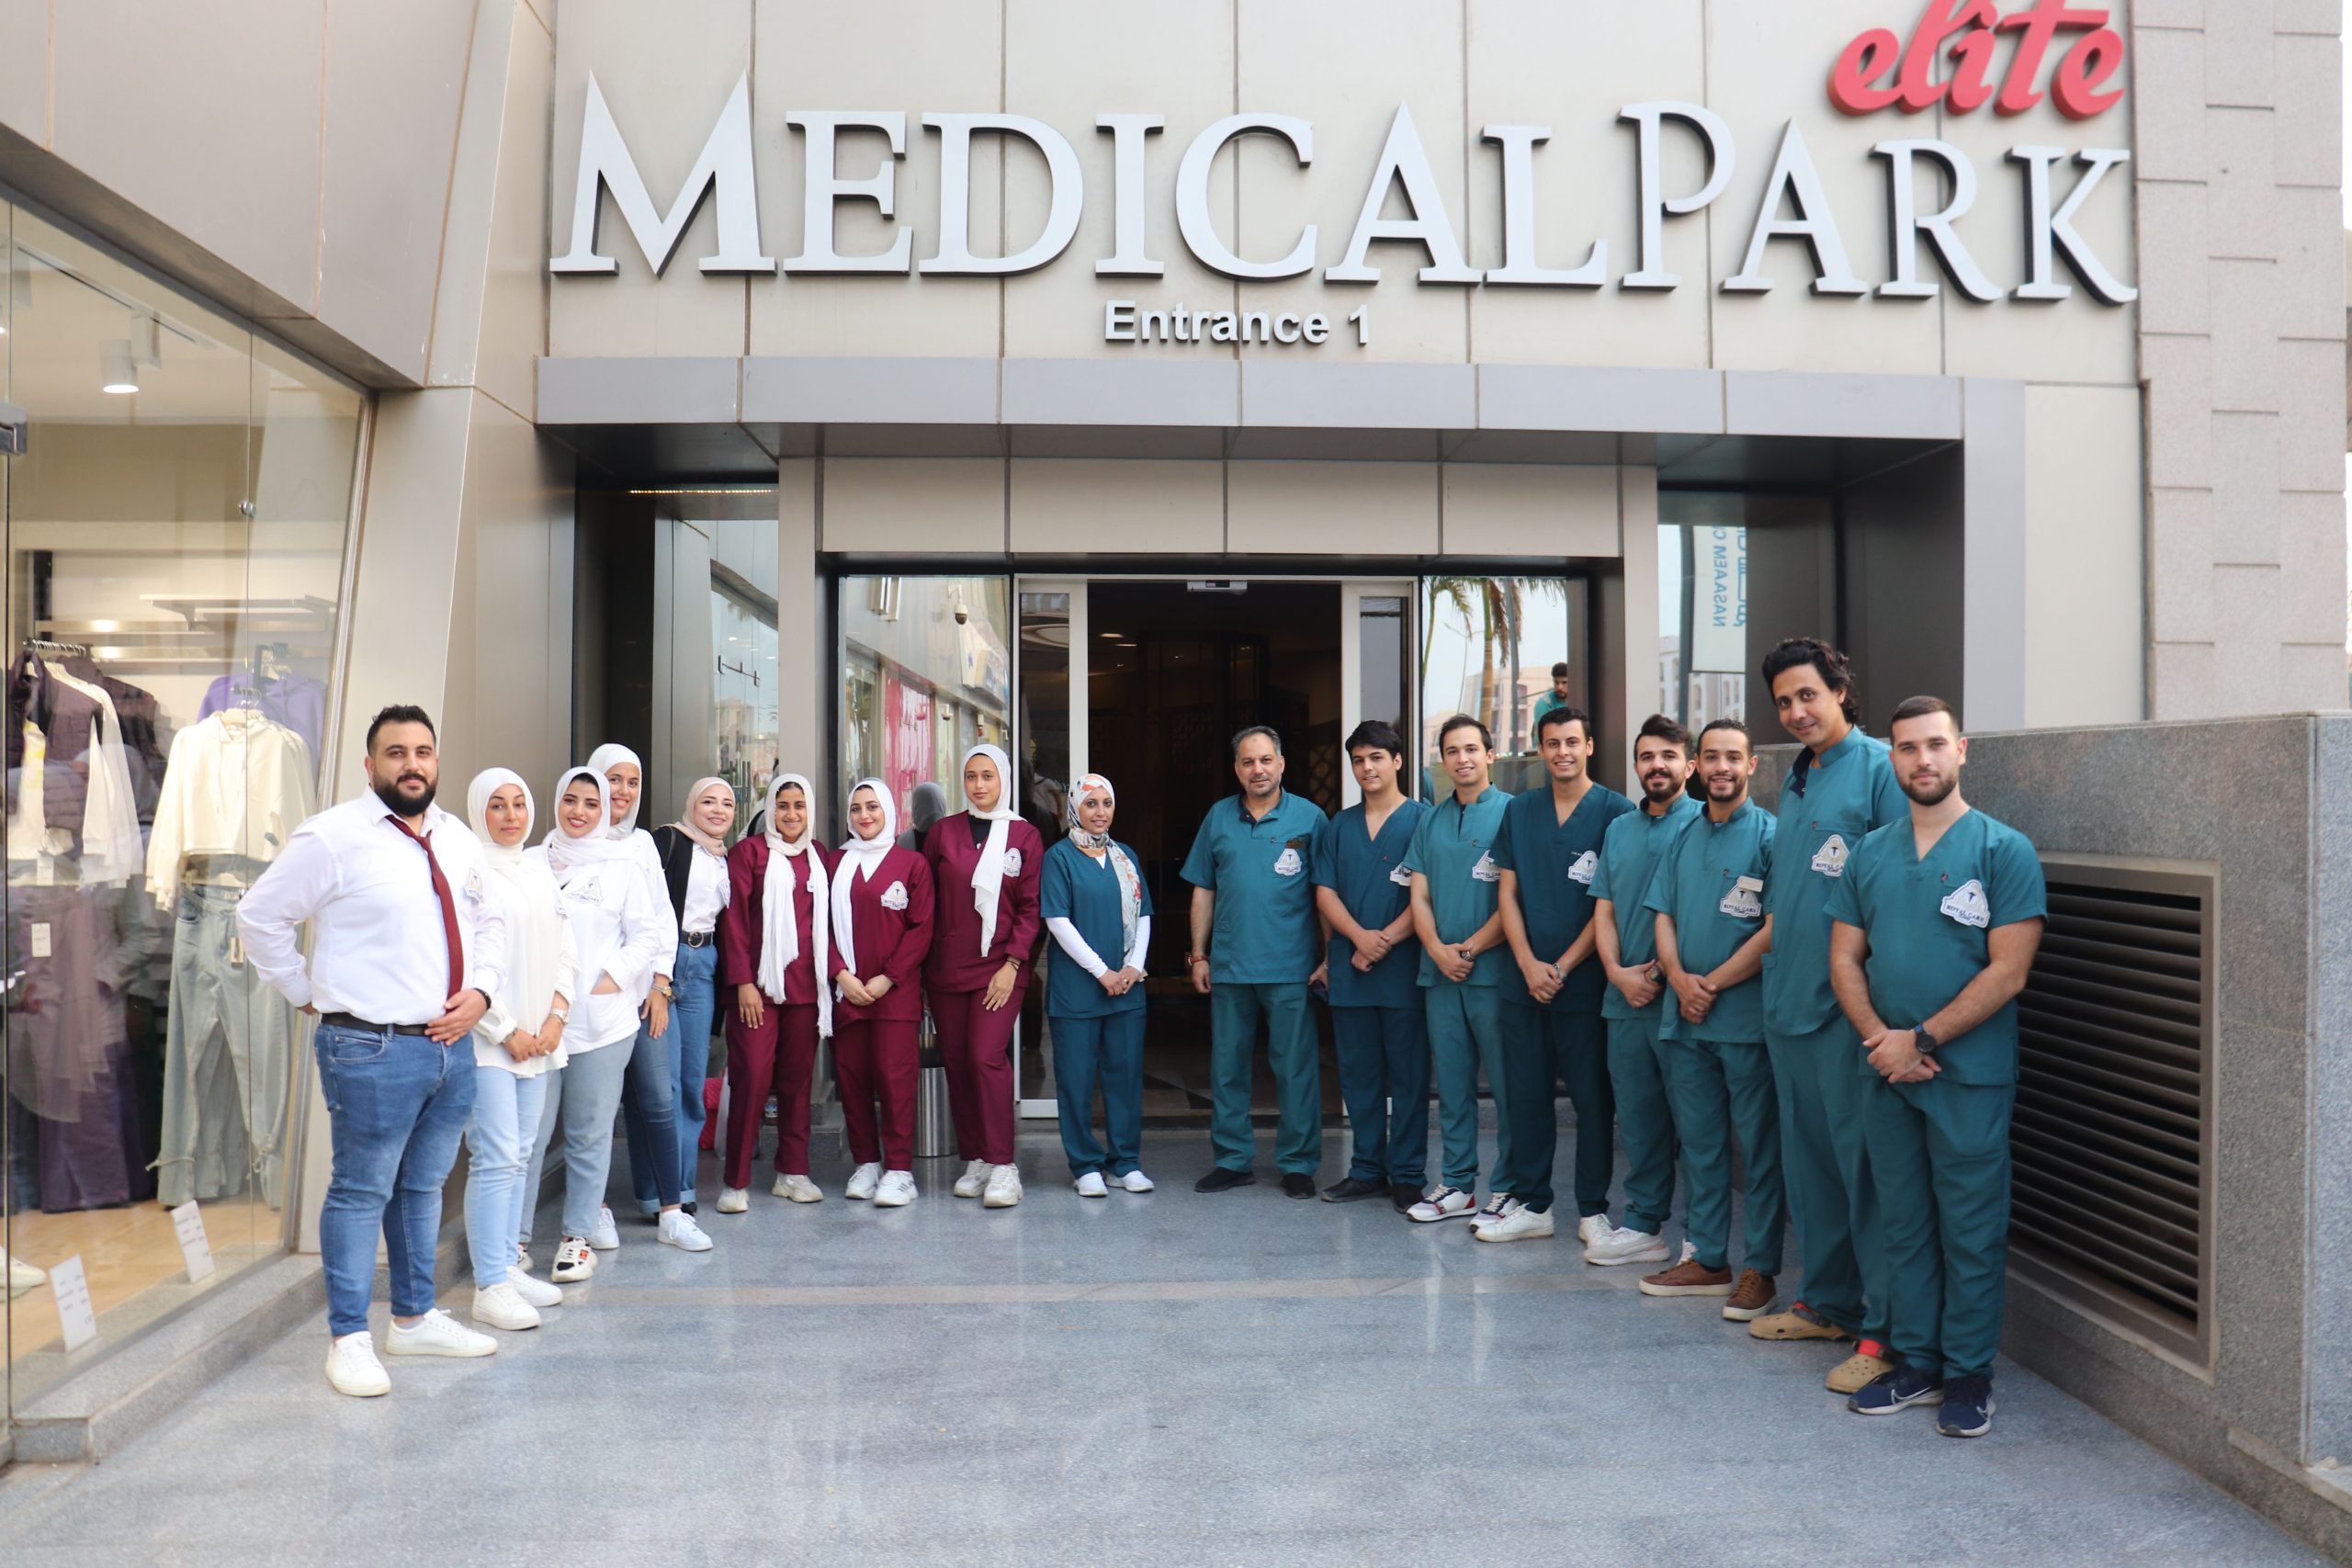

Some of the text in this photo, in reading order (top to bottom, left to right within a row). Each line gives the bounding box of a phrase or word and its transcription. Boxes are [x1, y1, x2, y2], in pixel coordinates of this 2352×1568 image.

[1826, 0, 2126, 121] elite
[1105, 299, 1369, 345] Entrance 1
